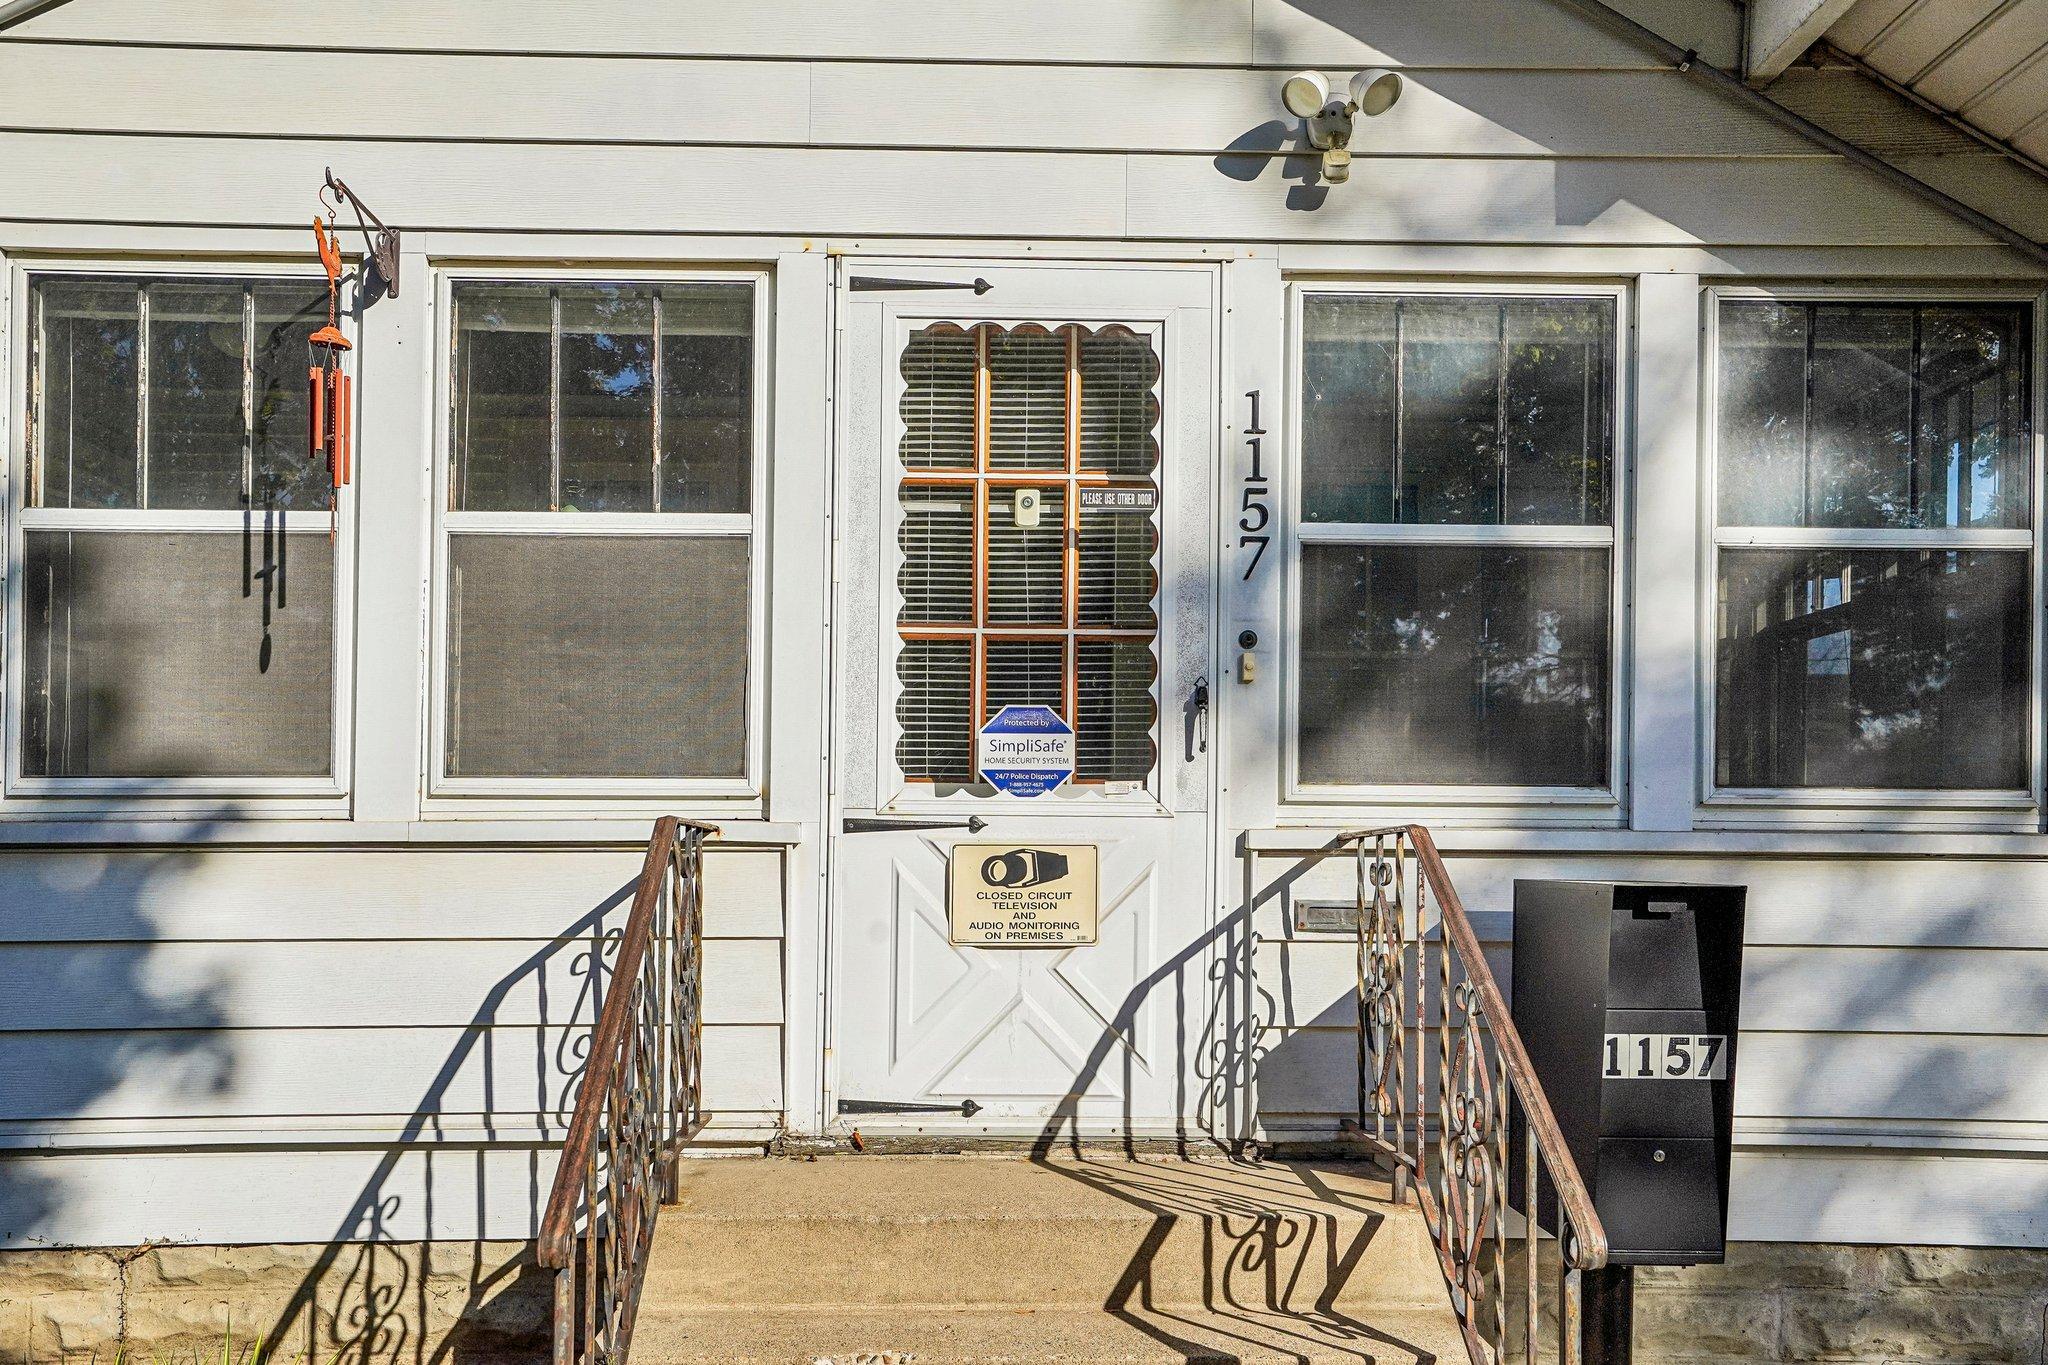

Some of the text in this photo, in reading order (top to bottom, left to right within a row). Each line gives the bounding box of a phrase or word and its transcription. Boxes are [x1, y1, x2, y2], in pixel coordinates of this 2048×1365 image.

[1239, 389, 1270, 581] 1157
[1082, 493, 1152, 505] PLEASE USE OTHER DOOR
[1004, 719, 1050, 728] Protected by
[984, 757, 1069, 765] HOME SECURITY SYSTEM
[1030, 773, 1059, 781] Dispatch
[976, 892, 1072, 900] CLOSED CIRCUIT
[992, 902, 1057, 910] TELEVISION
[1012, 912, 1037, 920] AND
[969, 922, 1080, 930] AUDIO MONITORING
[984, 932, 1001, 940] ON
[1006, 932, 1064, 940] PREMISES
[1605, 1037, 1724, 1076] 1157
